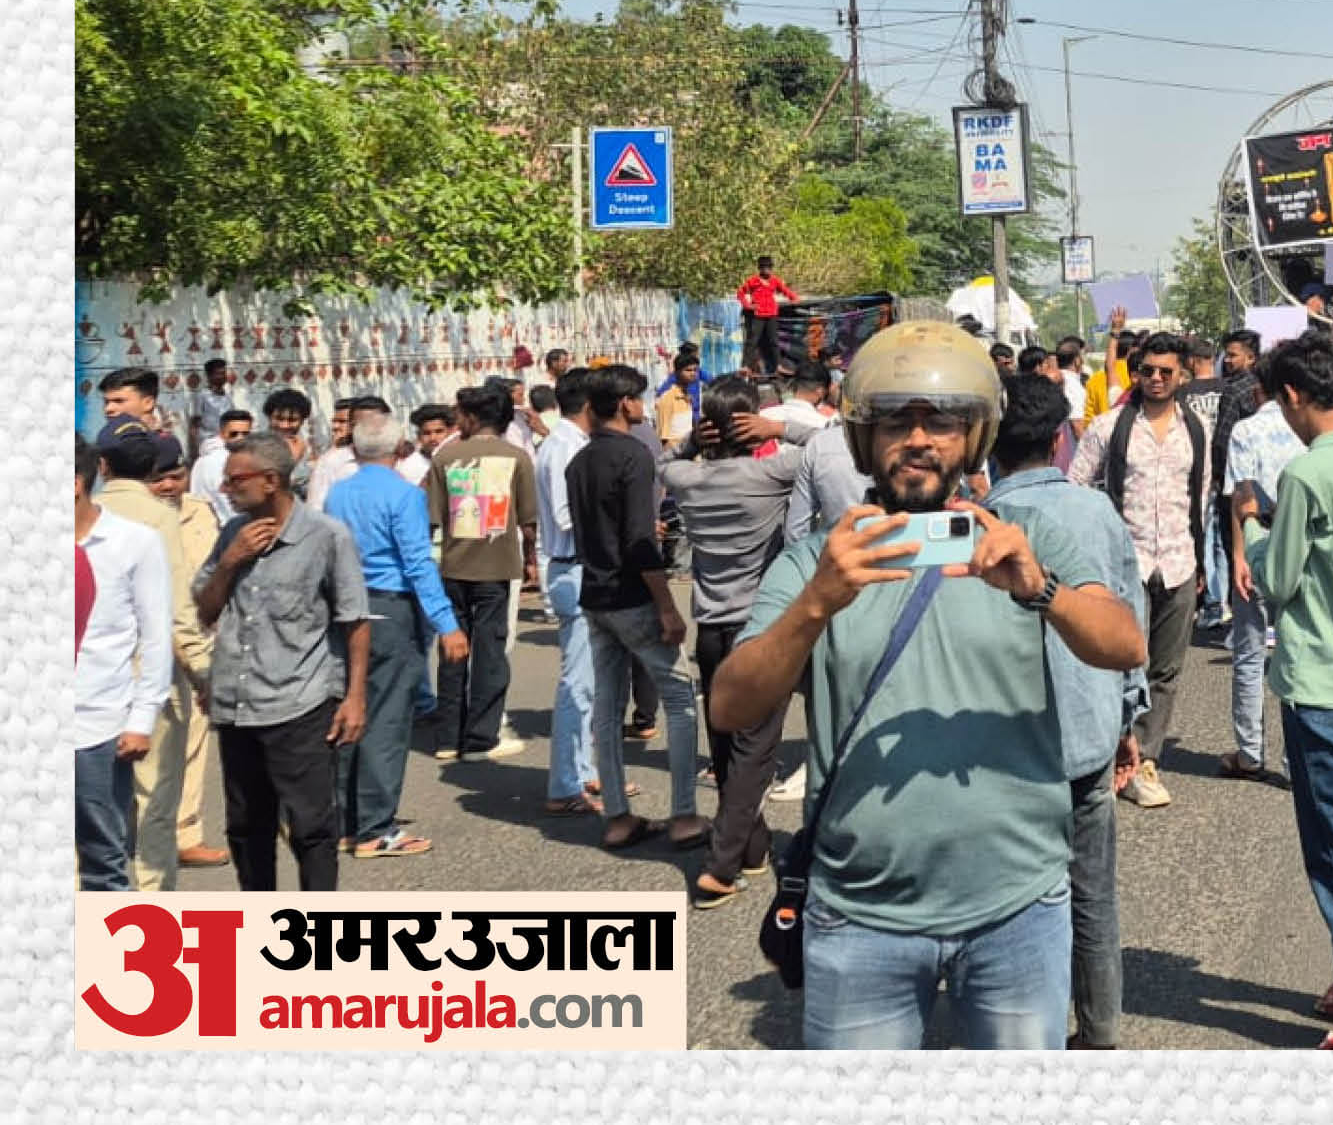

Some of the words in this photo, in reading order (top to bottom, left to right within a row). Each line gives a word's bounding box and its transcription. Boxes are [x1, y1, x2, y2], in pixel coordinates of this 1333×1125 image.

[963, 115, 1015, 129] RKDF
[976, 143, 1005, 156] BA
[975, 159, 1007, 171] MA
